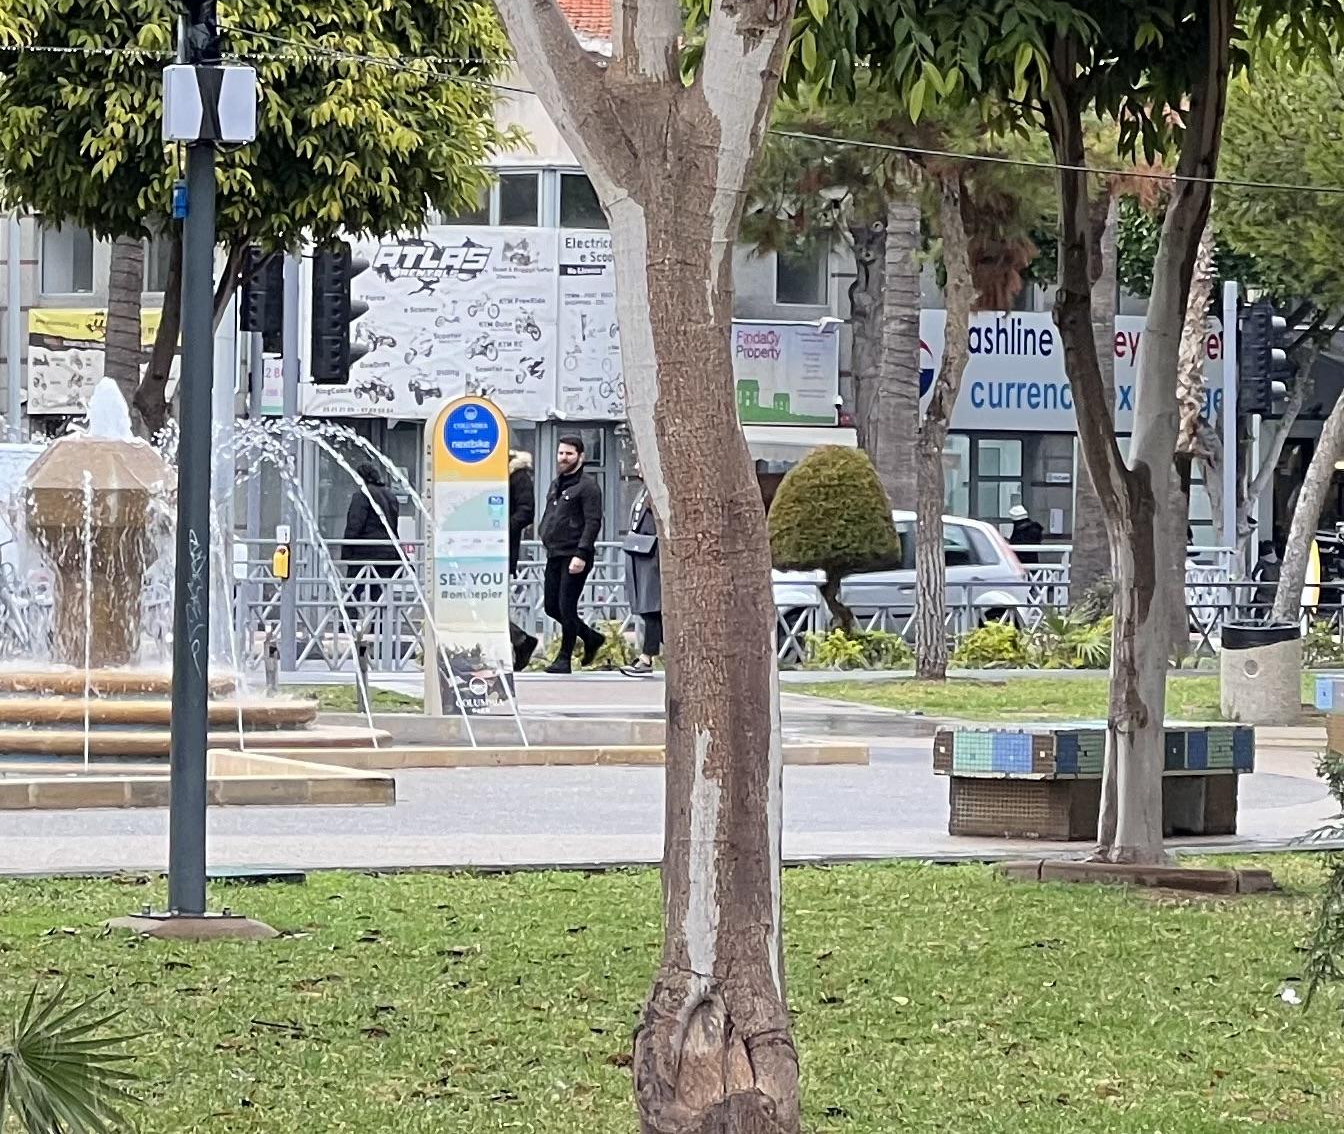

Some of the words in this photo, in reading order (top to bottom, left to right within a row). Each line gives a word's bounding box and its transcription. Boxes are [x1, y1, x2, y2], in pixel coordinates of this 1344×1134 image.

[373, 245, 493, 269] ATLAS
[590, 251, 613, 262] Scoo
[433, 332, 462, 340] Scooter
[968, 317, 1053, 356] ashline
[736, 345, 782, 360] Property
[971, 380, 1072, 409] currenc
[470, 572, 504, 585] YOU
